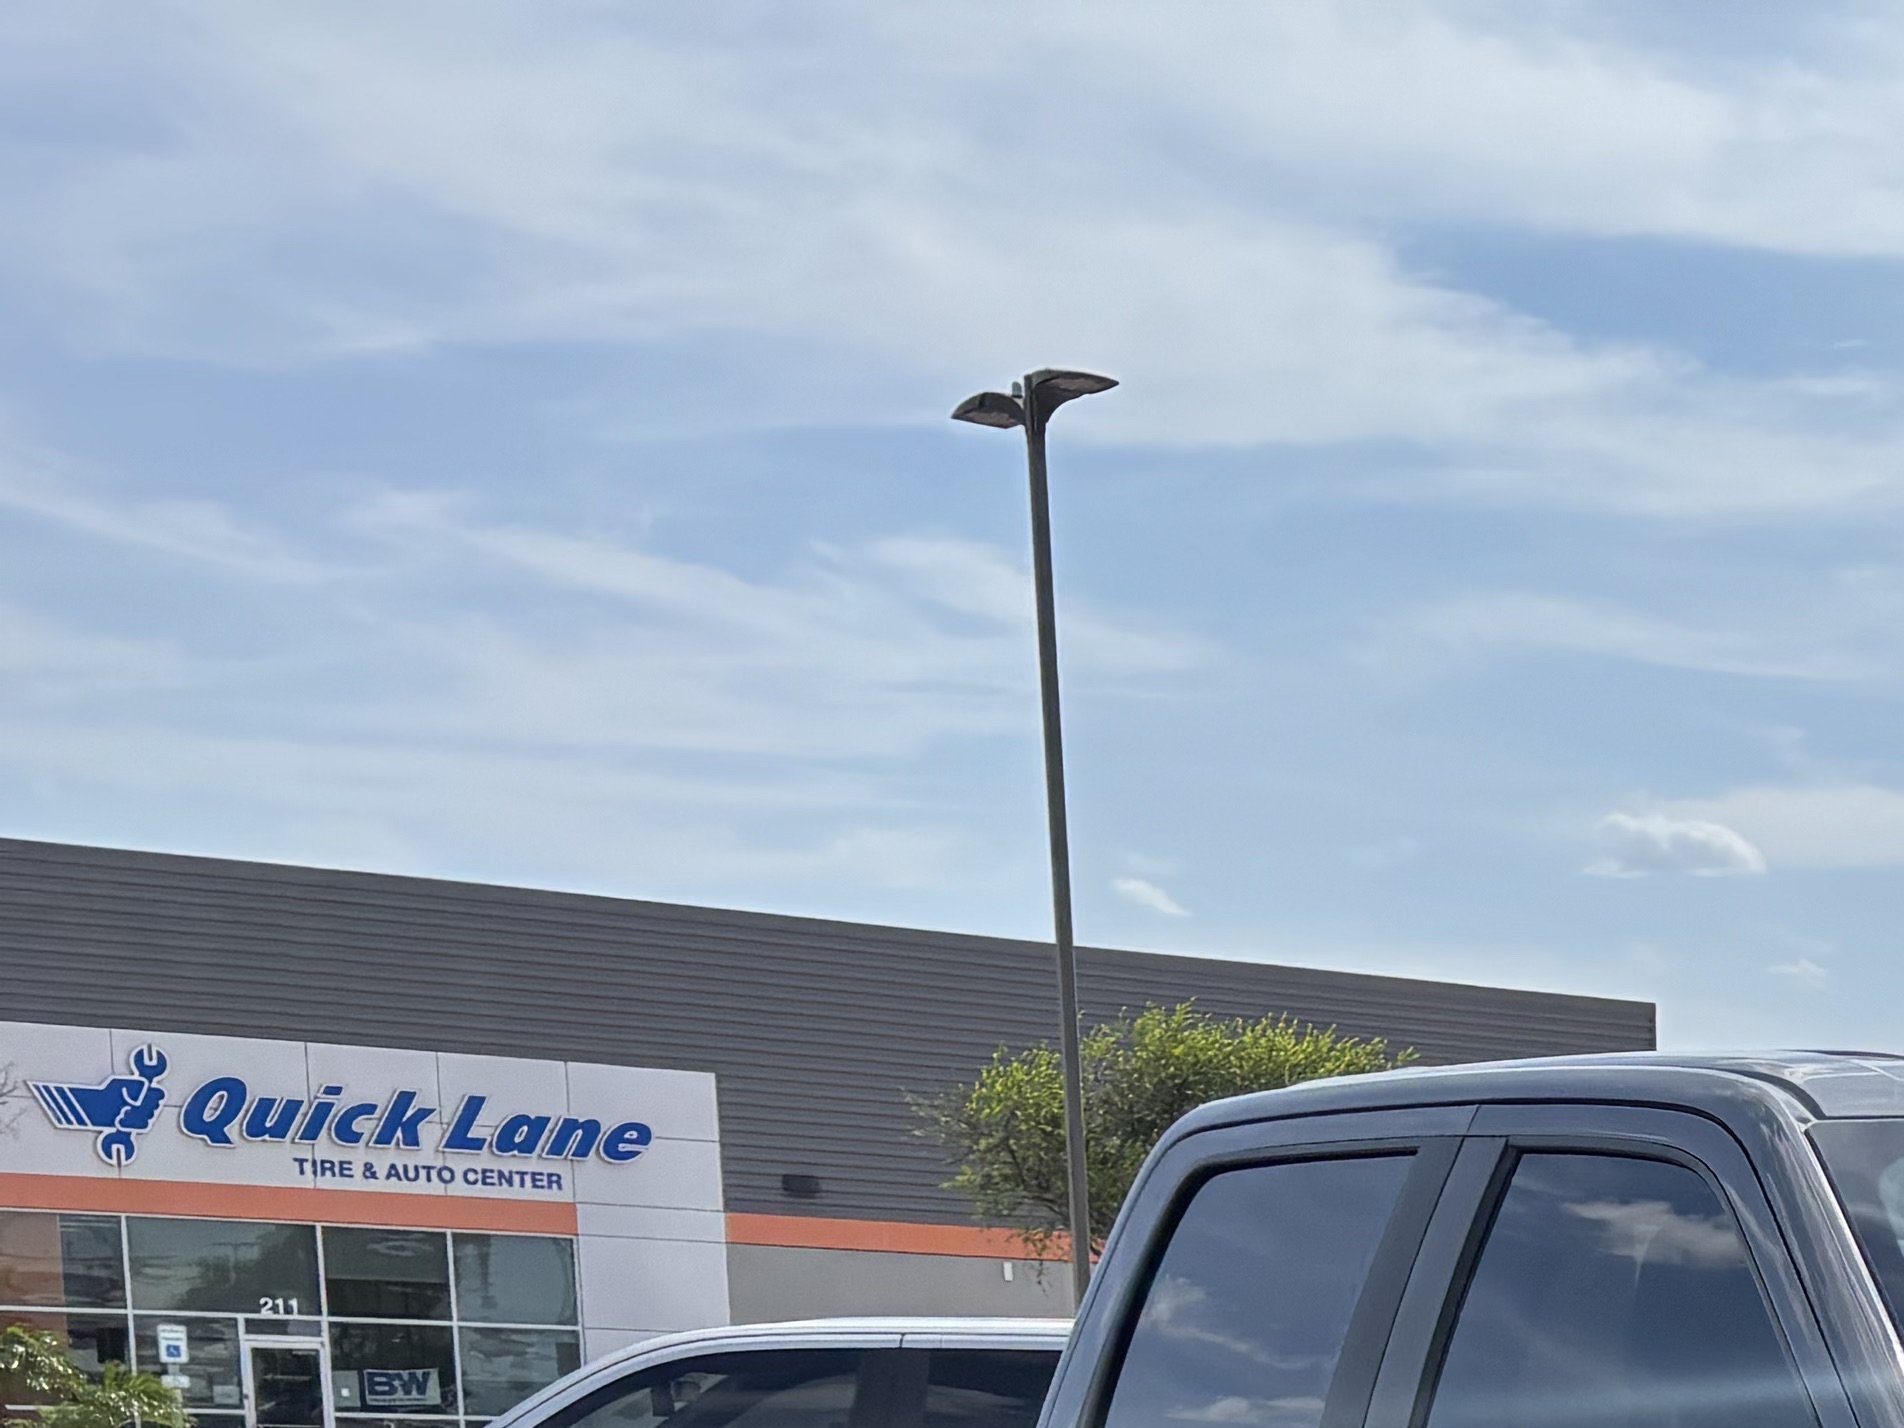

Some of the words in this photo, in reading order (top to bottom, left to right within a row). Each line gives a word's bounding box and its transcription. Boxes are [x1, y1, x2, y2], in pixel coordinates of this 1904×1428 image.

[180, 1076, 436, 1148] Quick
[440, 1094, 653, 1164] Lane
[293, 1157, 355, 1179] TIRE
[362, 1161, 379, 1180] &
[385, 1163, 456, 1184] AUTO
[462, 1167, 563, 1191] CENTER
[259, 1296, 299, 1316] 211
